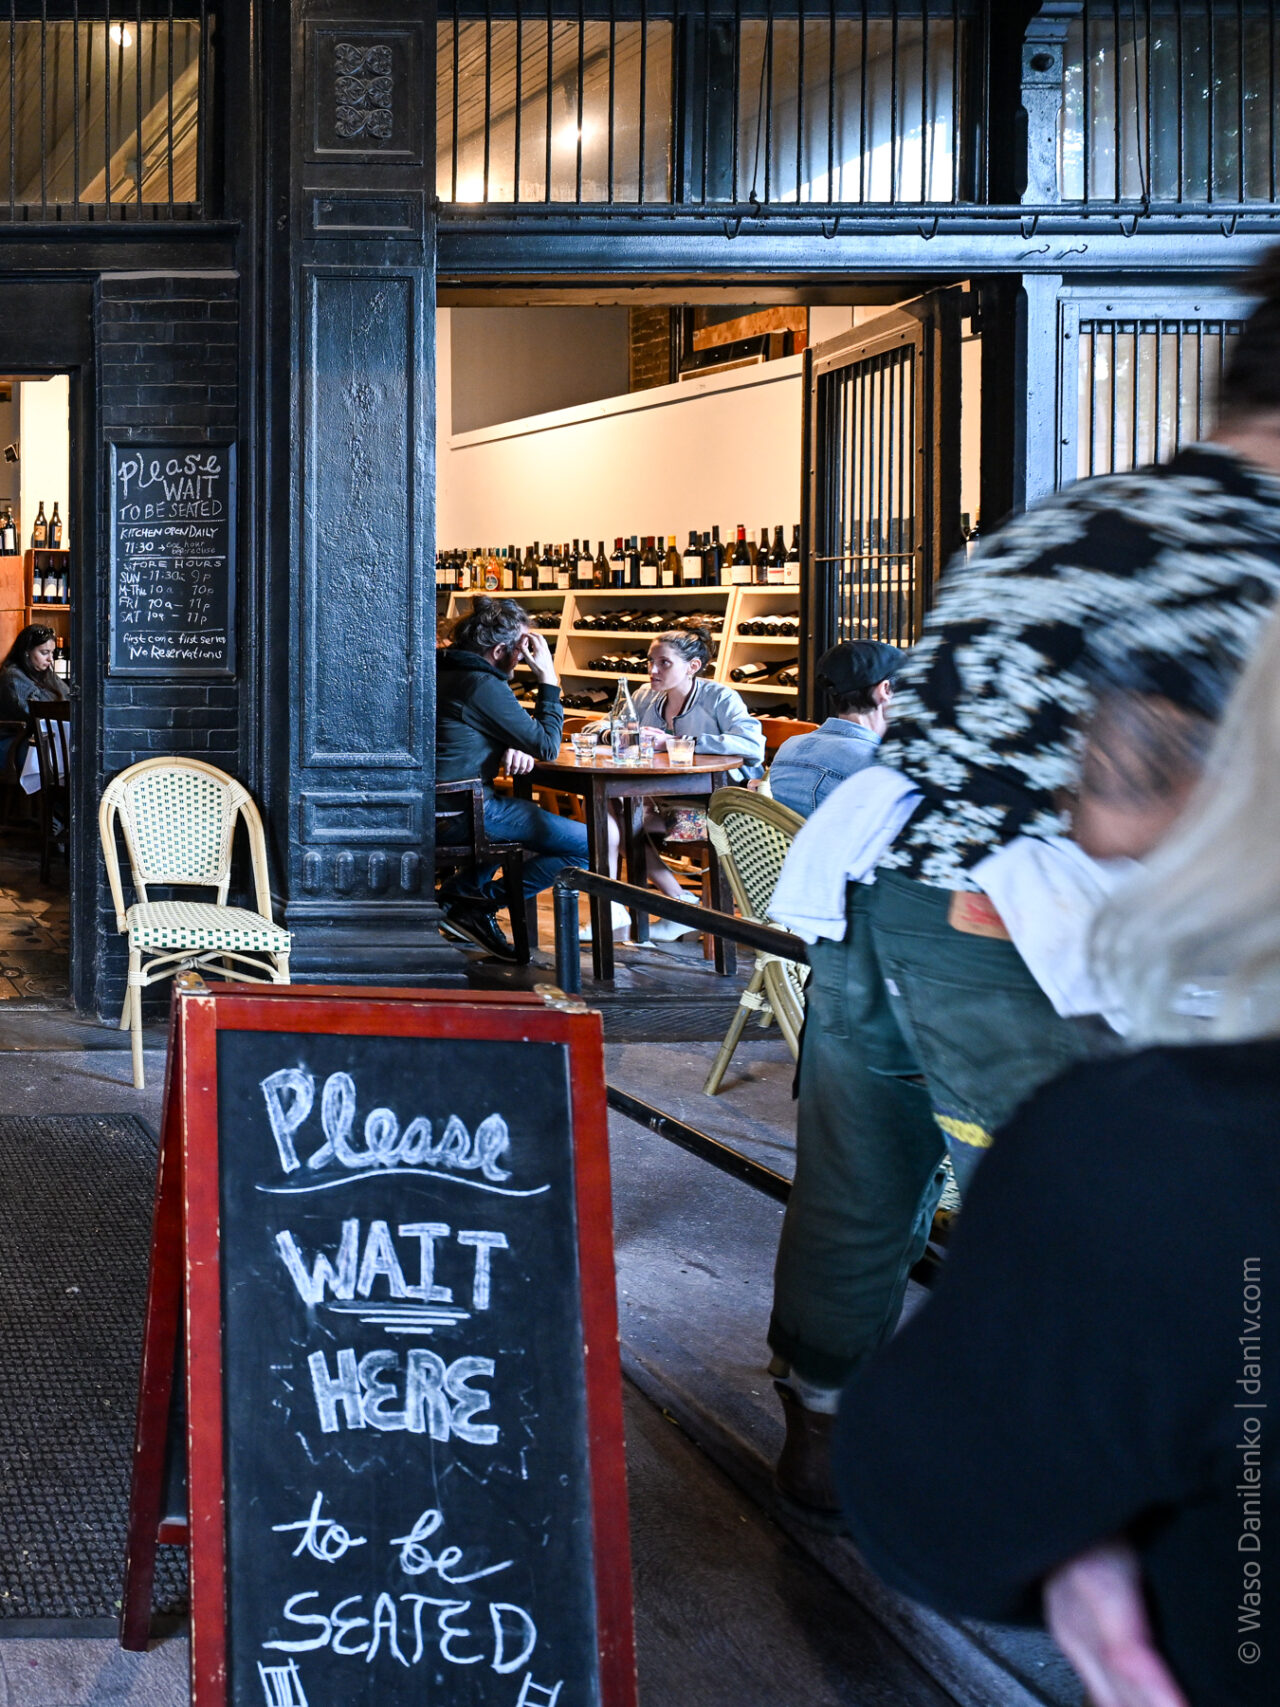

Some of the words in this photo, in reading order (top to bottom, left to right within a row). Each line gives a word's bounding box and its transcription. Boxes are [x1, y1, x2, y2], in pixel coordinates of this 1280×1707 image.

[162, 475, 220, 501] WAIT
[119, 503, 141, 520] TO
[144, 501, 166, 519] BE
[168, 500, 223, 518] SEATED
[120, 526, 163, 540] KITCHEN
[164, 526, 189, 536] OPEN
[188, 525, 219, 538] DAILY
[183, 540, 206, 548] hour
[123, 560, 168, 571] STORE
[174, 560, 222, 569] HOURS
[120, 571, 141, 584] SUN
[119, 597, 139, 609] FRI
[120, 610, 142, 624] SAT
[122, 632, 146, 645] first
[147, 635, 175, 644] come
[178, 632, 199, 644] first
[129, 646, 149, 660] No
[150, 644, 222, 660] Reservations
[259, 1066, 513, 1182] Please
[274, 1218, 510, 1310] WAIT
[306, 1347, 501, 1445] HERE
[271, 1490, 368, 1564] to
[388, 1508, 514, 1584] be
[261, 1591, 537, 1674] SEATED
